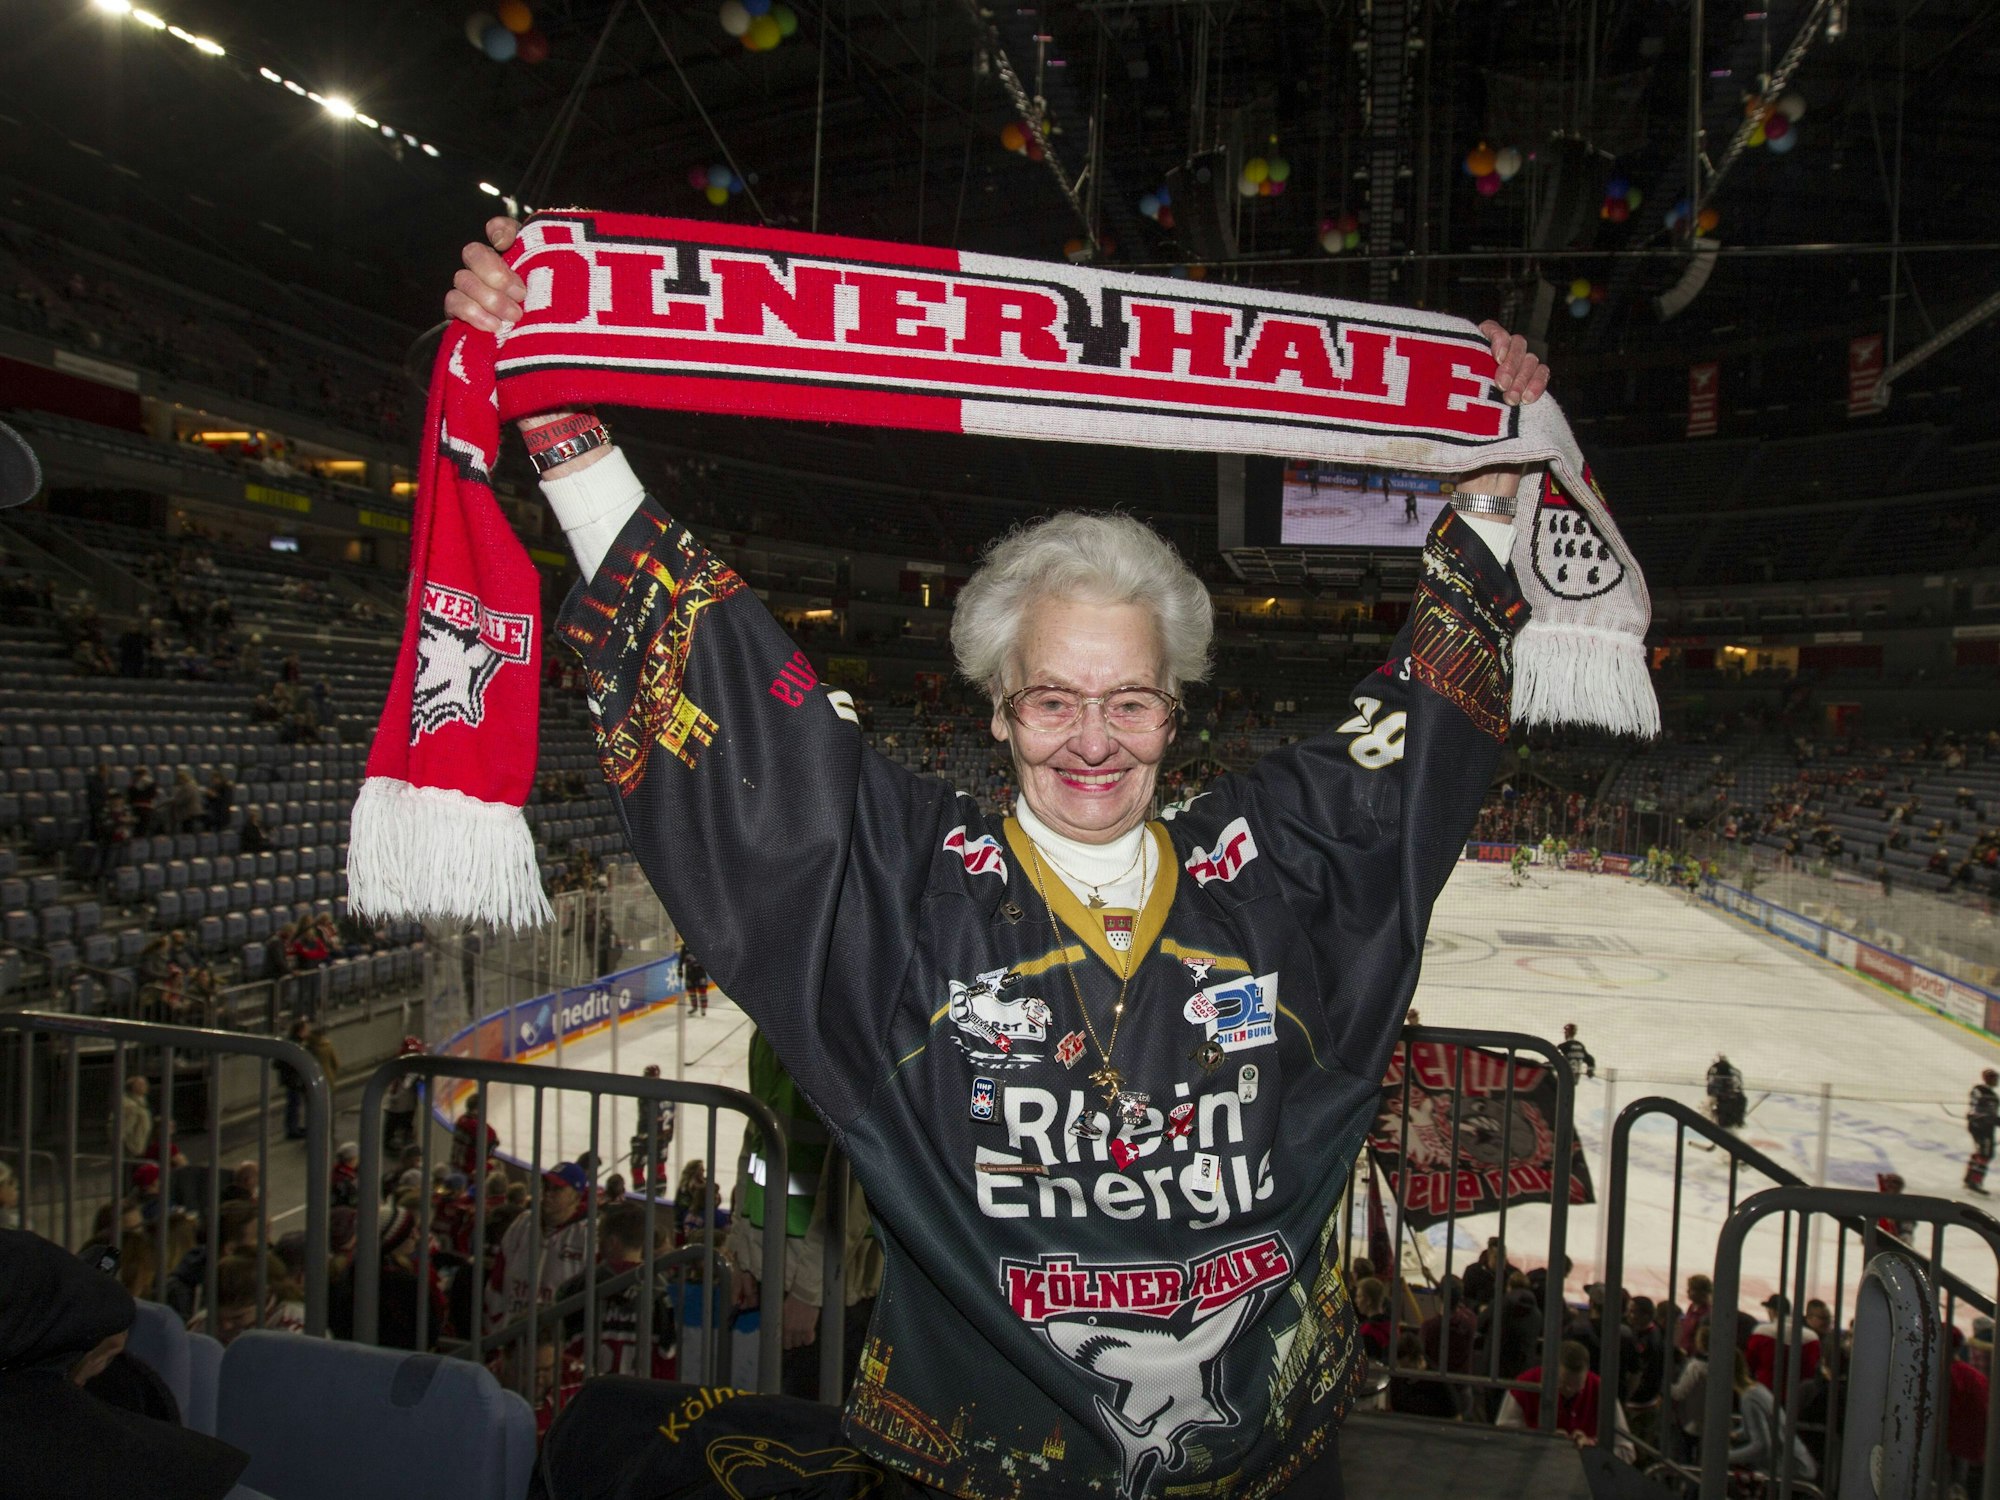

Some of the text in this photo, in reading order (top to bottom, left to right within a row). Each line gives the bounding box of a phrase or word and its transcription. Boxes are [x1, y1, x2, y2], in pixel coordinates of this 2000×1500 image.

[506, 226, 1503, 436] ÖLNER HAIE
[1318, 474, 1358, 486] mediteo
[423, 589, 474, 622] NER
[552, 988, 631, 1035] medito
[1195, 993, 1218, 1017] PLAY-OFF
[1004, 1082, 1243, 1166] Rhein
[1009, 1240, 1291, 1319] KÖLNER HAIE
